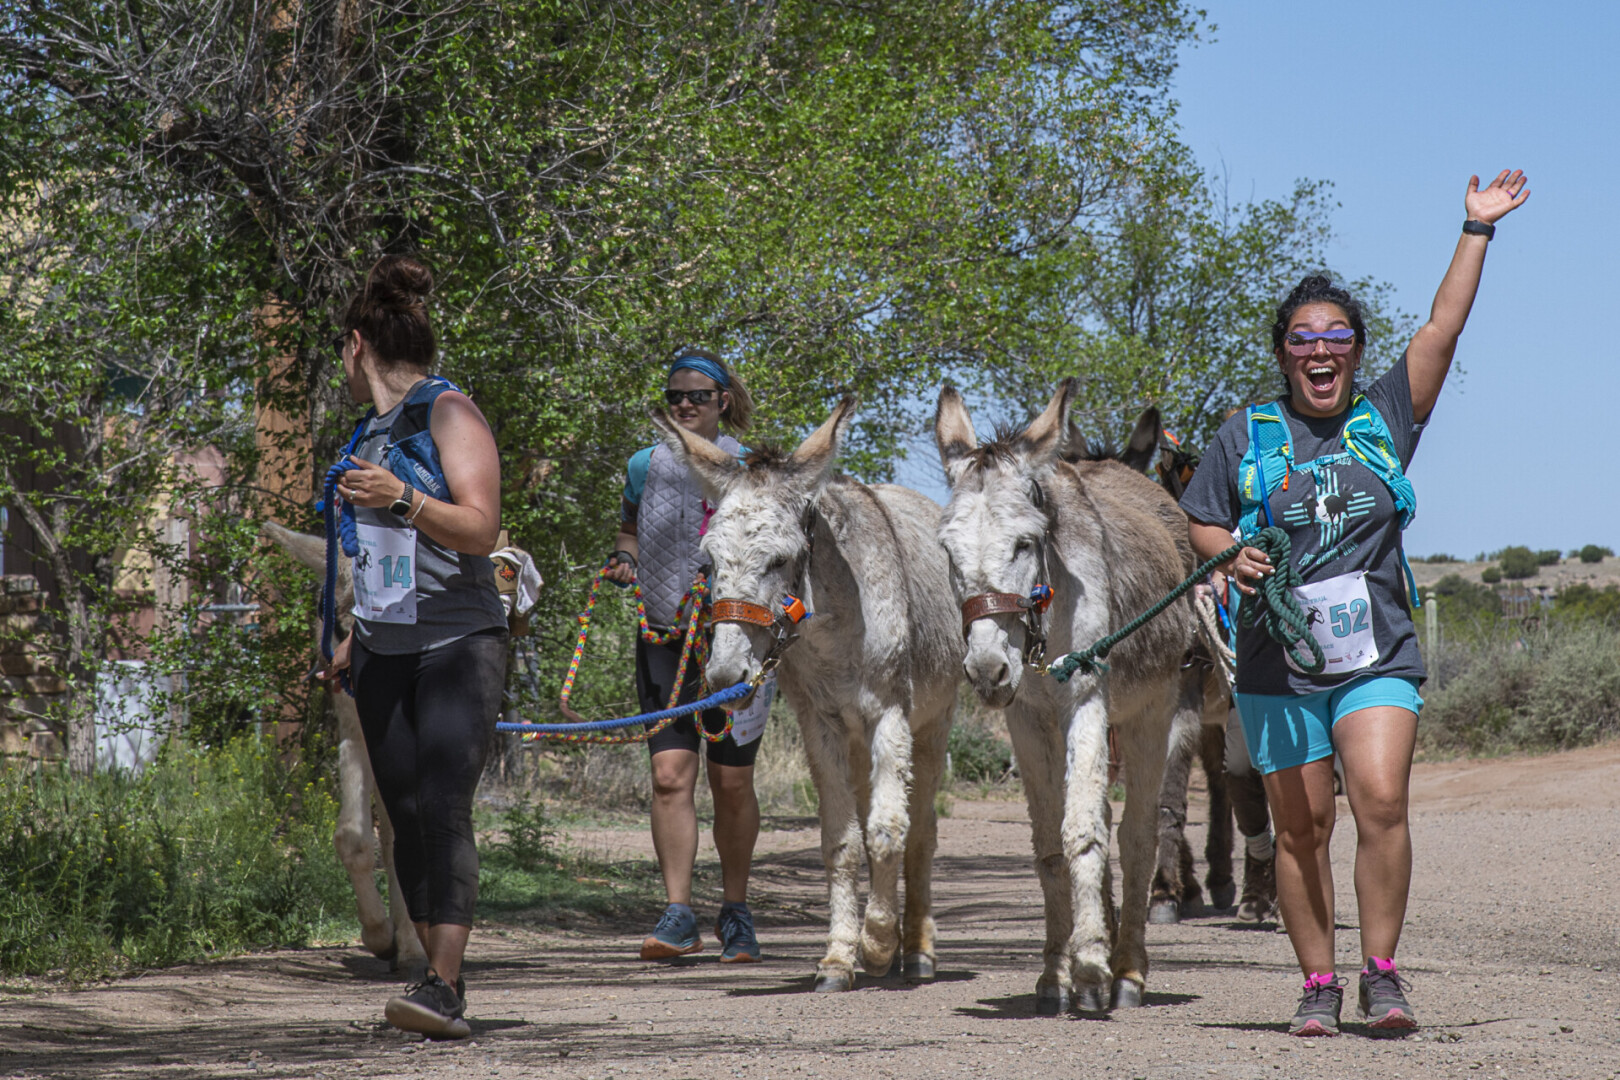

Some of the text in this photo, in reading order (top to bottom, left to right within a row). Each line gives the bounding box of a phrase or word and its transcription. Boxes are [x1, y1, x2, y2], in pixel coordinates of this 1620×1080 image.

[412, 462, 441, 494] CAMELBAK
[378, 554, 413, 589] 14
[1309, 595, 1328, 605] TRAIL
[1329, 598, 1369, 638] 52
